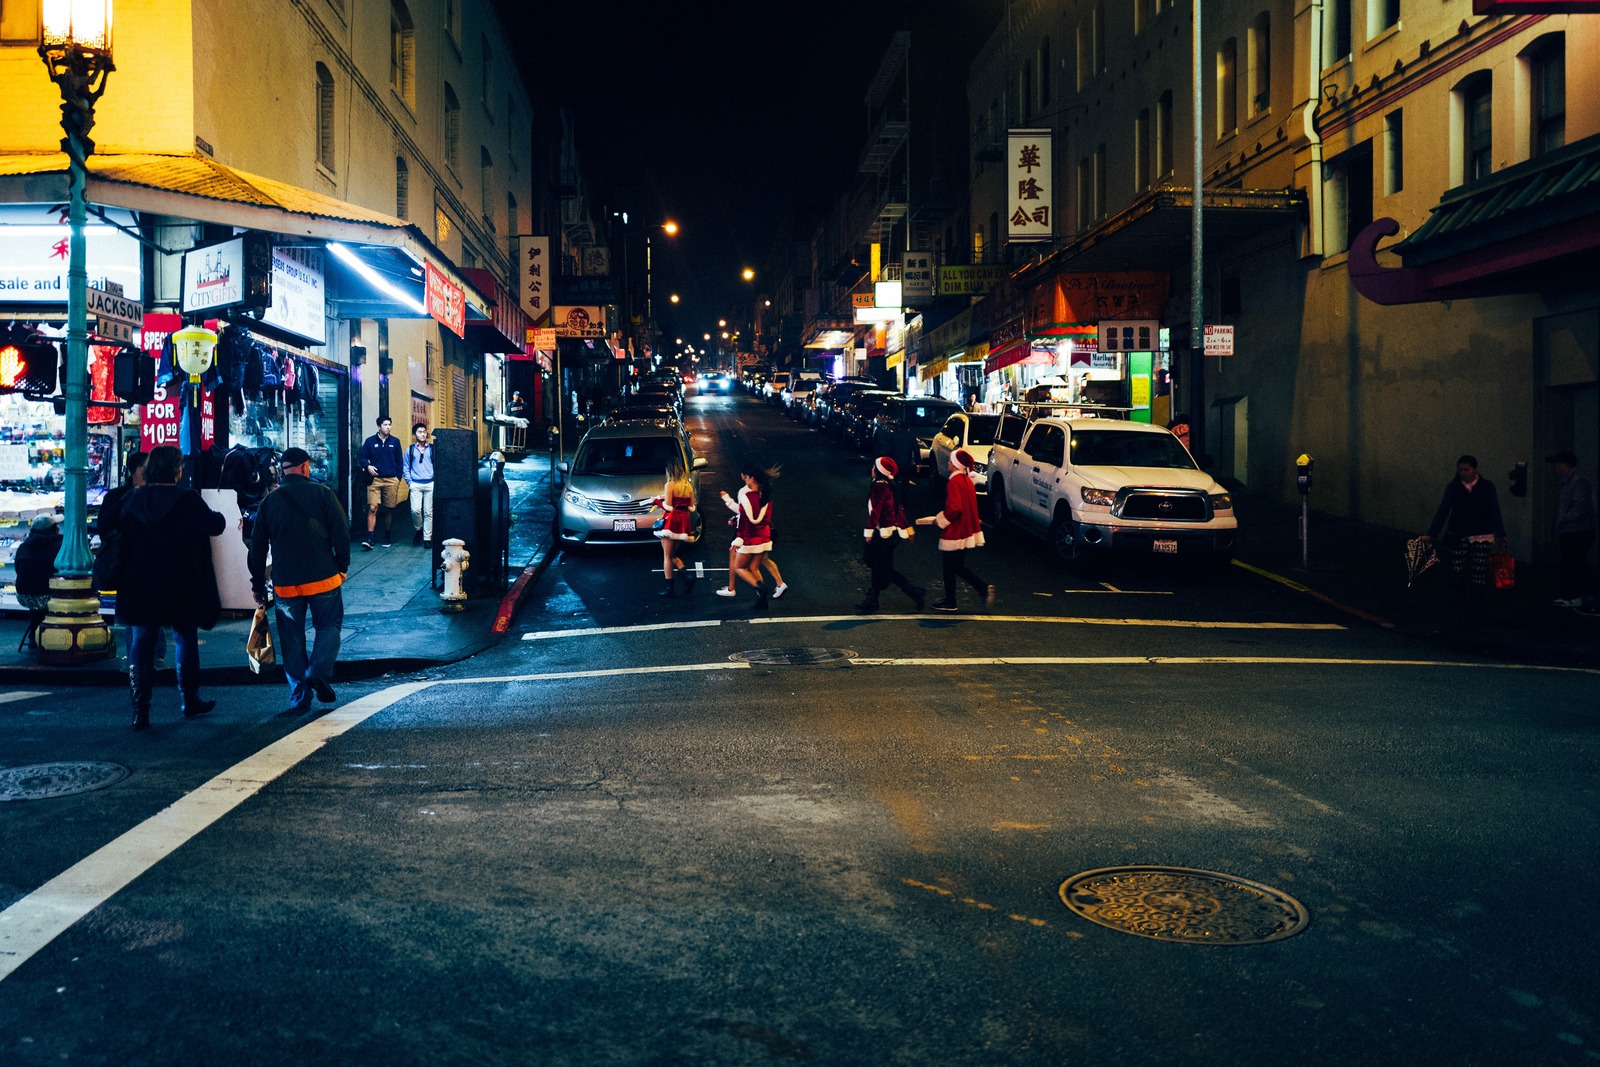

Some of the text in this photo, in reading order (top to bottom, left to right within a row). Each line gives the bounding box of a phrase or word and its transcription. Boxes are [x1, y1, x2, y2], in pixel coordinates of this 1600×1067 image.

[34, 276, 61, 289] and
[944, 281, 961, 292] DIM
[88, 293, 141, 322] JACKSON
[1205, 326, 1213, 335] NO
[1092, 353, 1116, 361] Marlboro
[154, 381, 167, 401] 5
[147, 403, 175, 418] FOR
[203, 401, 213, 415] FOR
